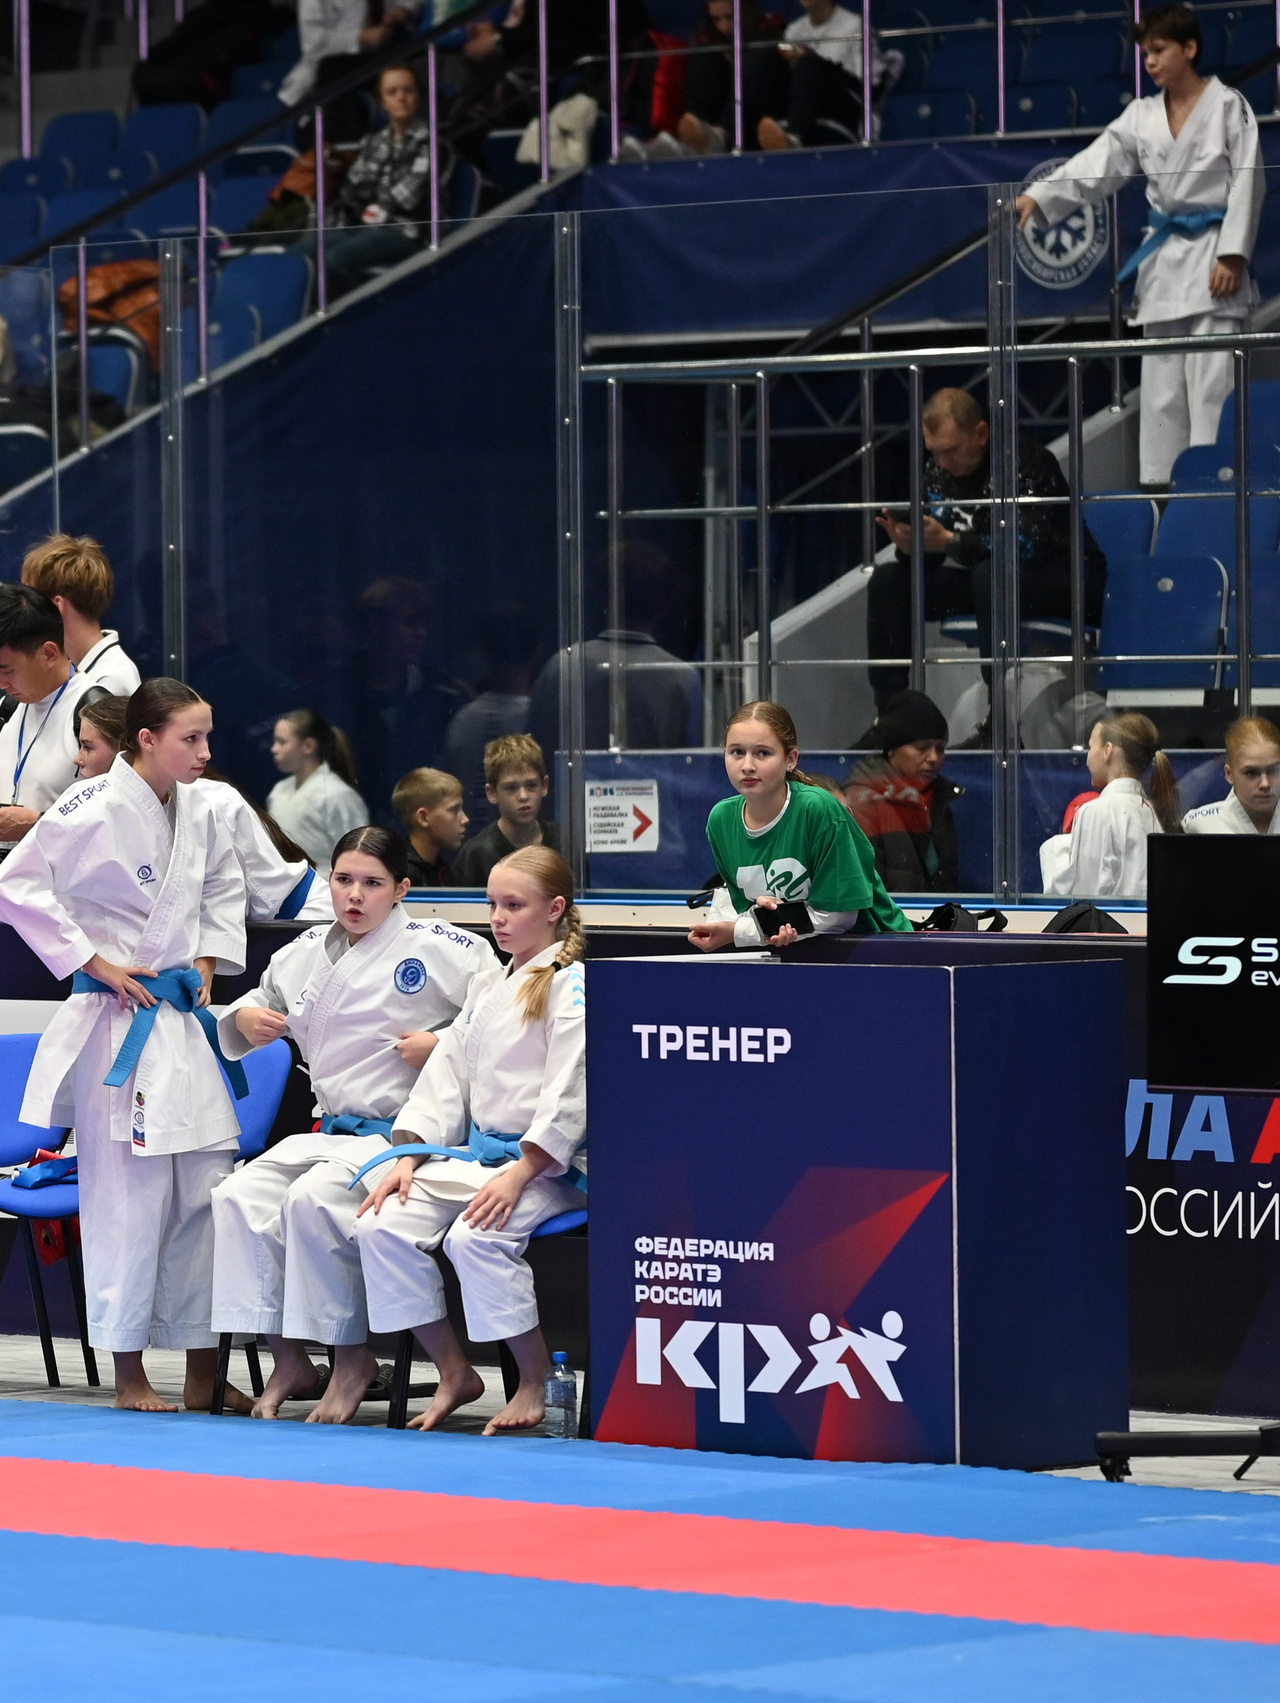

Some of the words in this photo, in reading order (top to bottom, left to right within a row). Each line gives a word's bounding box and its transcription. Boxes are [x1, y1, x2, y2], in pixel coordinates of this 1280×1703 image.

[58, 795, 83, 816] BEST
[81, 779, 112, 801] SPORT
[1189, 807, 1220, 819] SPORT
[430, 924, 475, 948] SPORT
[632, 1024, 792, 1063] ТРЕНЕР
[634, 1235, 775, 1263] ФЕДЕРАЦИЯ
[634, 1260, 722, 1283] КАРАТЭ
[634, 1284, 723, 1308] РОССИИ
